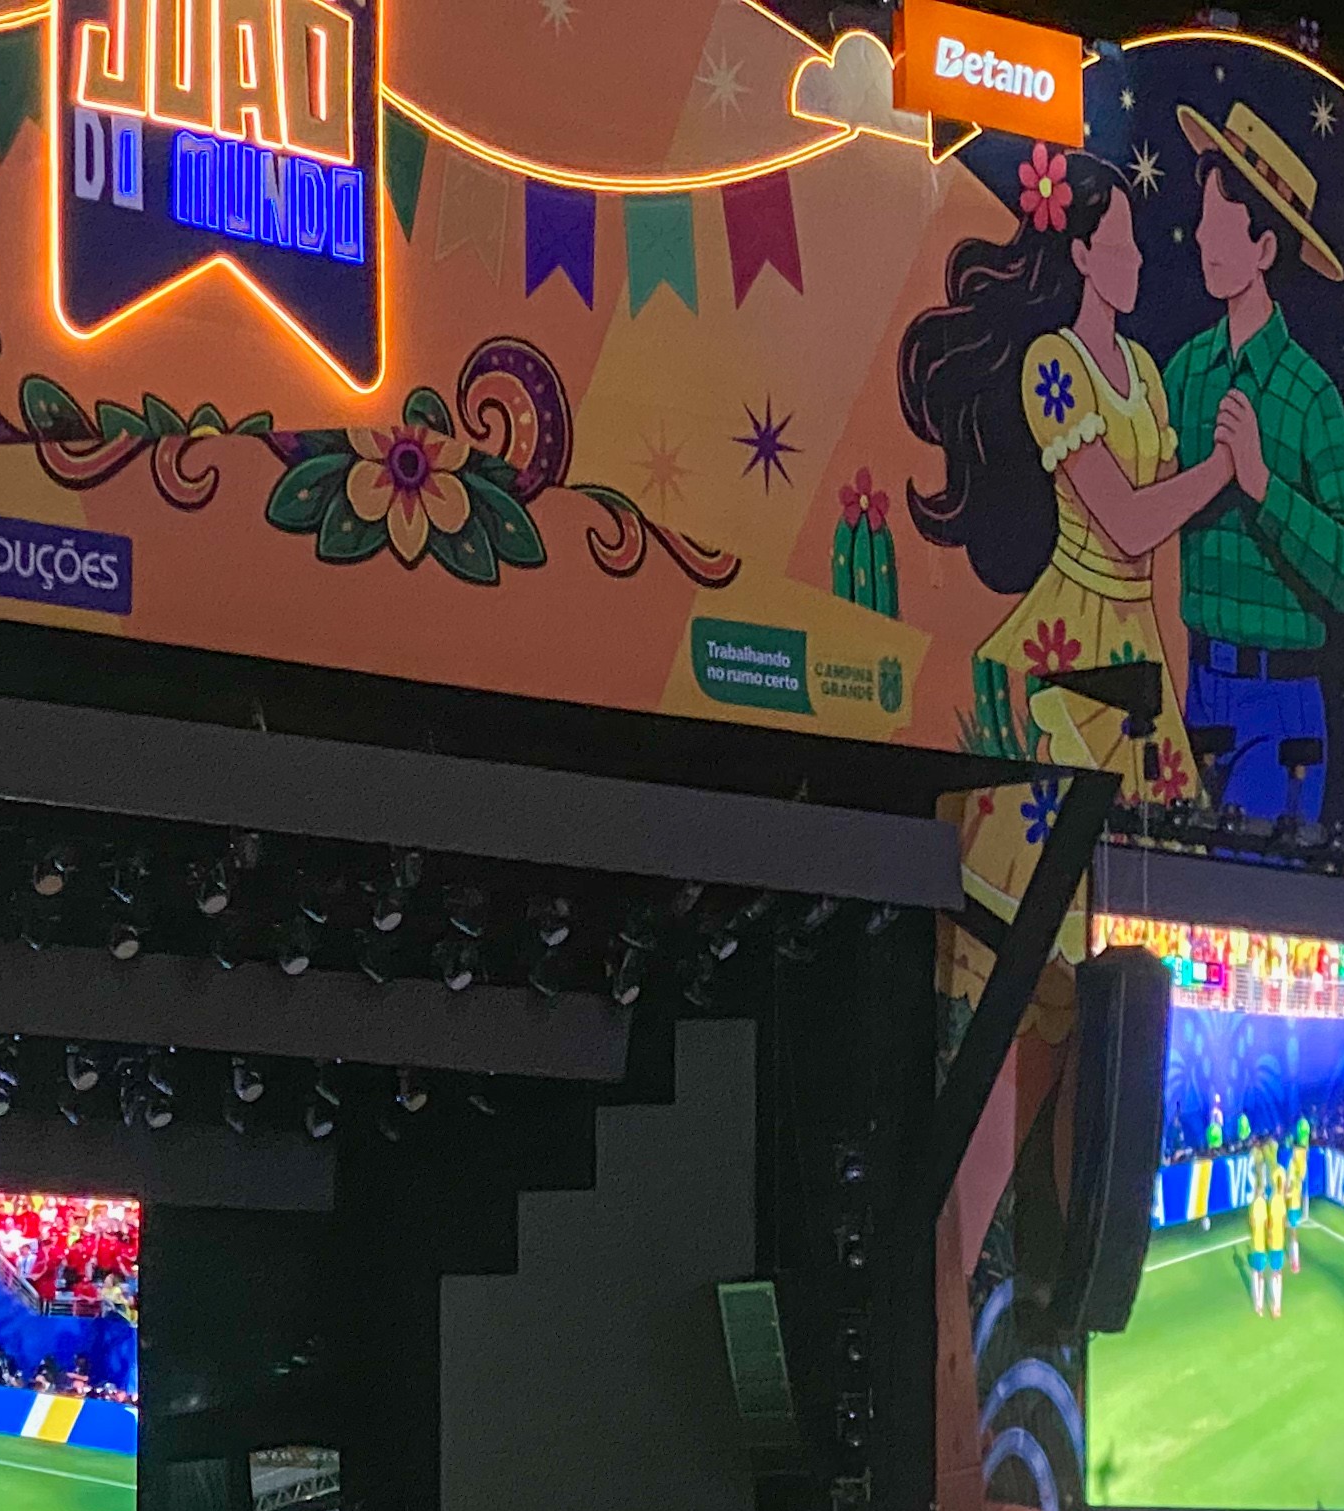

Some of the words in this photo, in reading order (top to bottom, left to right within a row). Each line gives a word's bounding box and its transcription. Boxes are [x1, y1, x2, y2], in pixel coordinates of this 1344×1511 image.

[935, 36, 1056, 103] Betano
[73, 106, 144, 212] DO
[175, 131, 365, 265] MUNDO
[706, 640, 791, 669] Trabalhando
[706, 665, 725, 681] no
[726, 669, 762, 686] rumo
[764, 673, 799, 691] certo
[814, 661, 874, 683] CAMPINA
[820, 680, 875, 701] GRANDE
[1228, 1156, 1267, 1209] VIS
